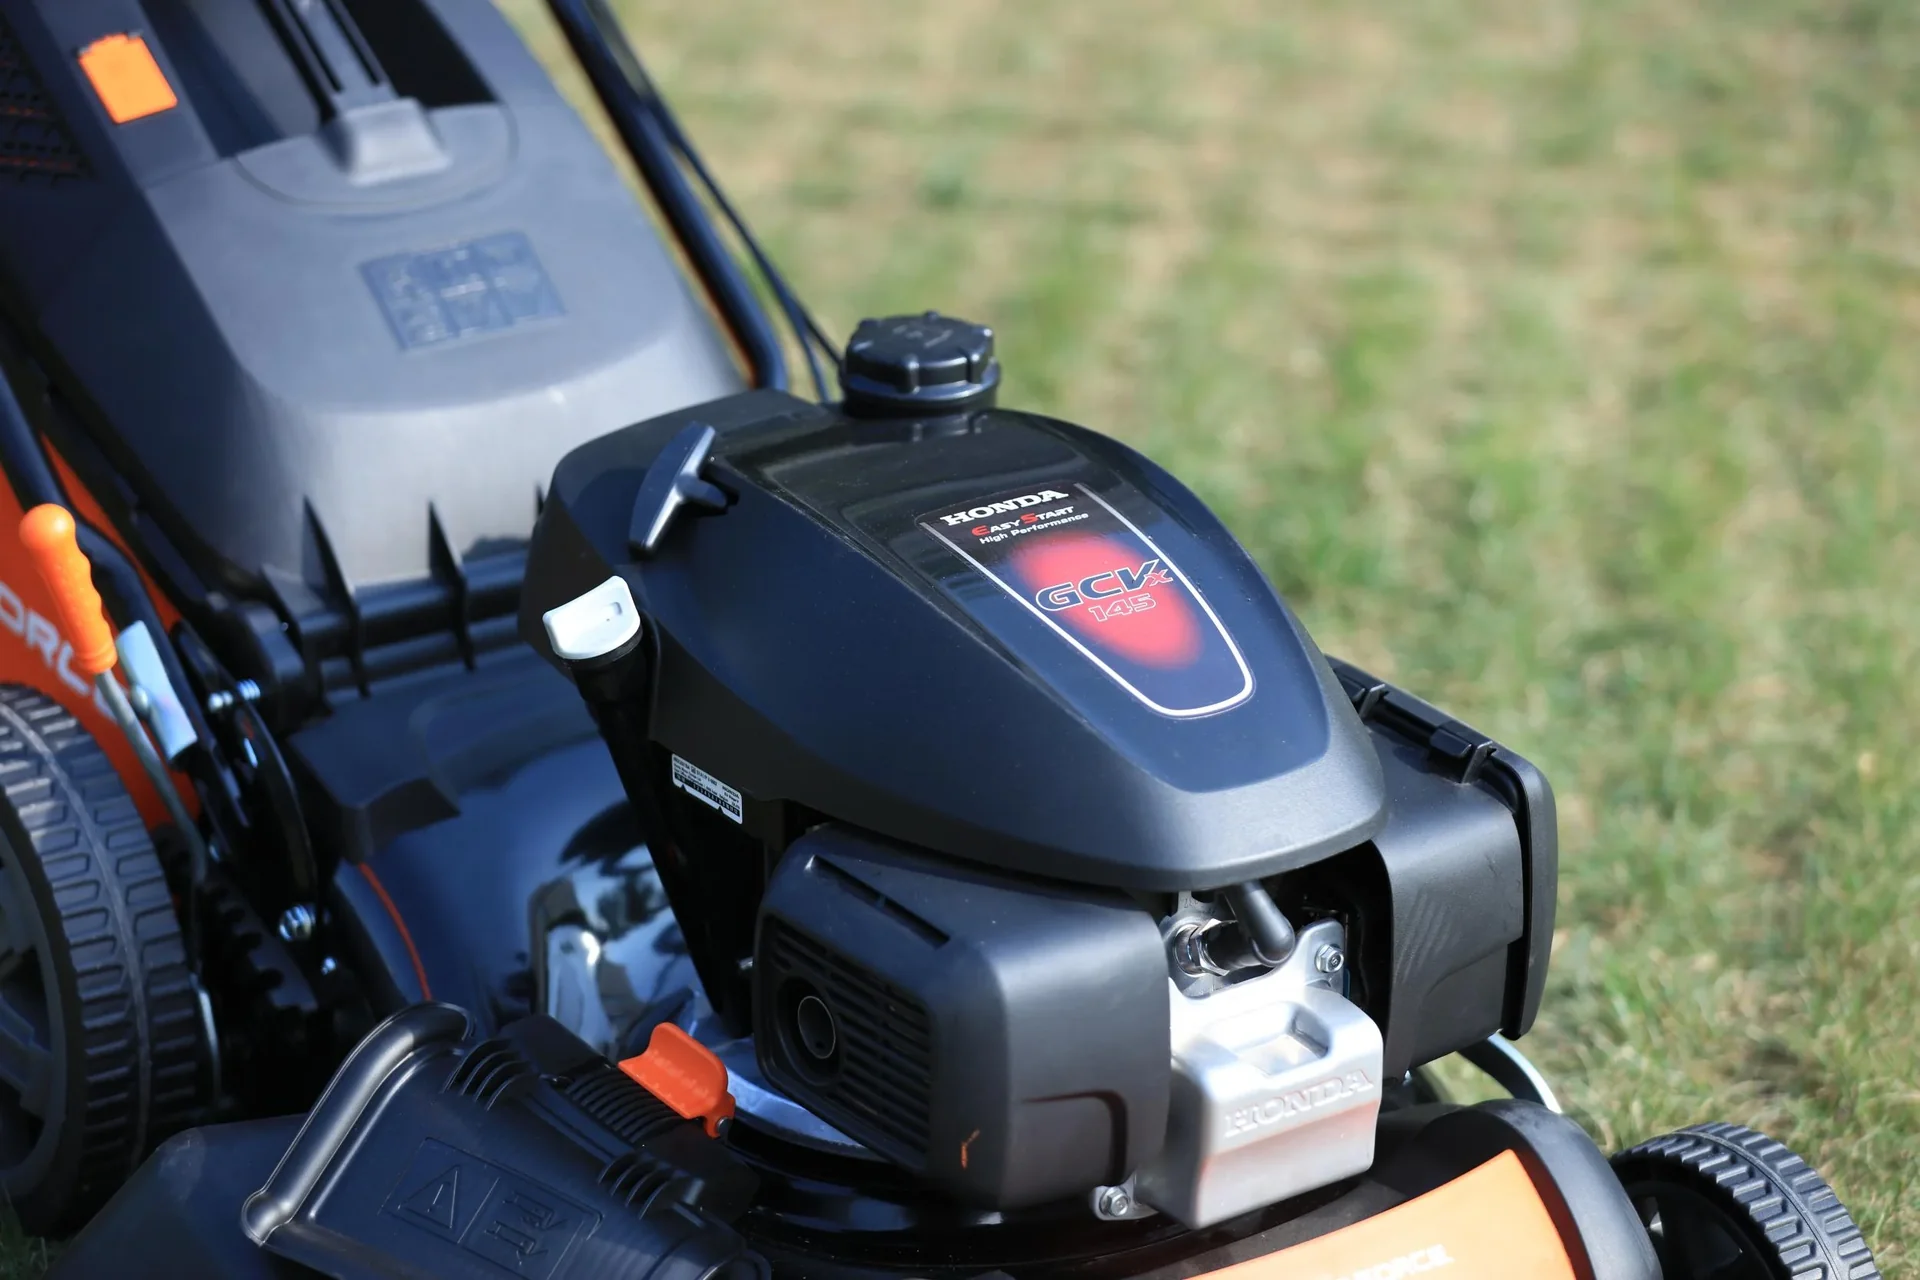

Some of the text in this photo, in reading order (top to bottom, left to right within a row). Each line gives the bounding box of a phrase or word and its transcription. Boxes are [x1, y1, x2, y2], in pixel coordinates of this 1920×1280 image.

[940, 489, 1069, 526] HONDA
[979, 512, 1090, 545] High Performance
[1088, 592, 1157, 622] 145
[1223, 1068, 1375, 1139] HONDA
